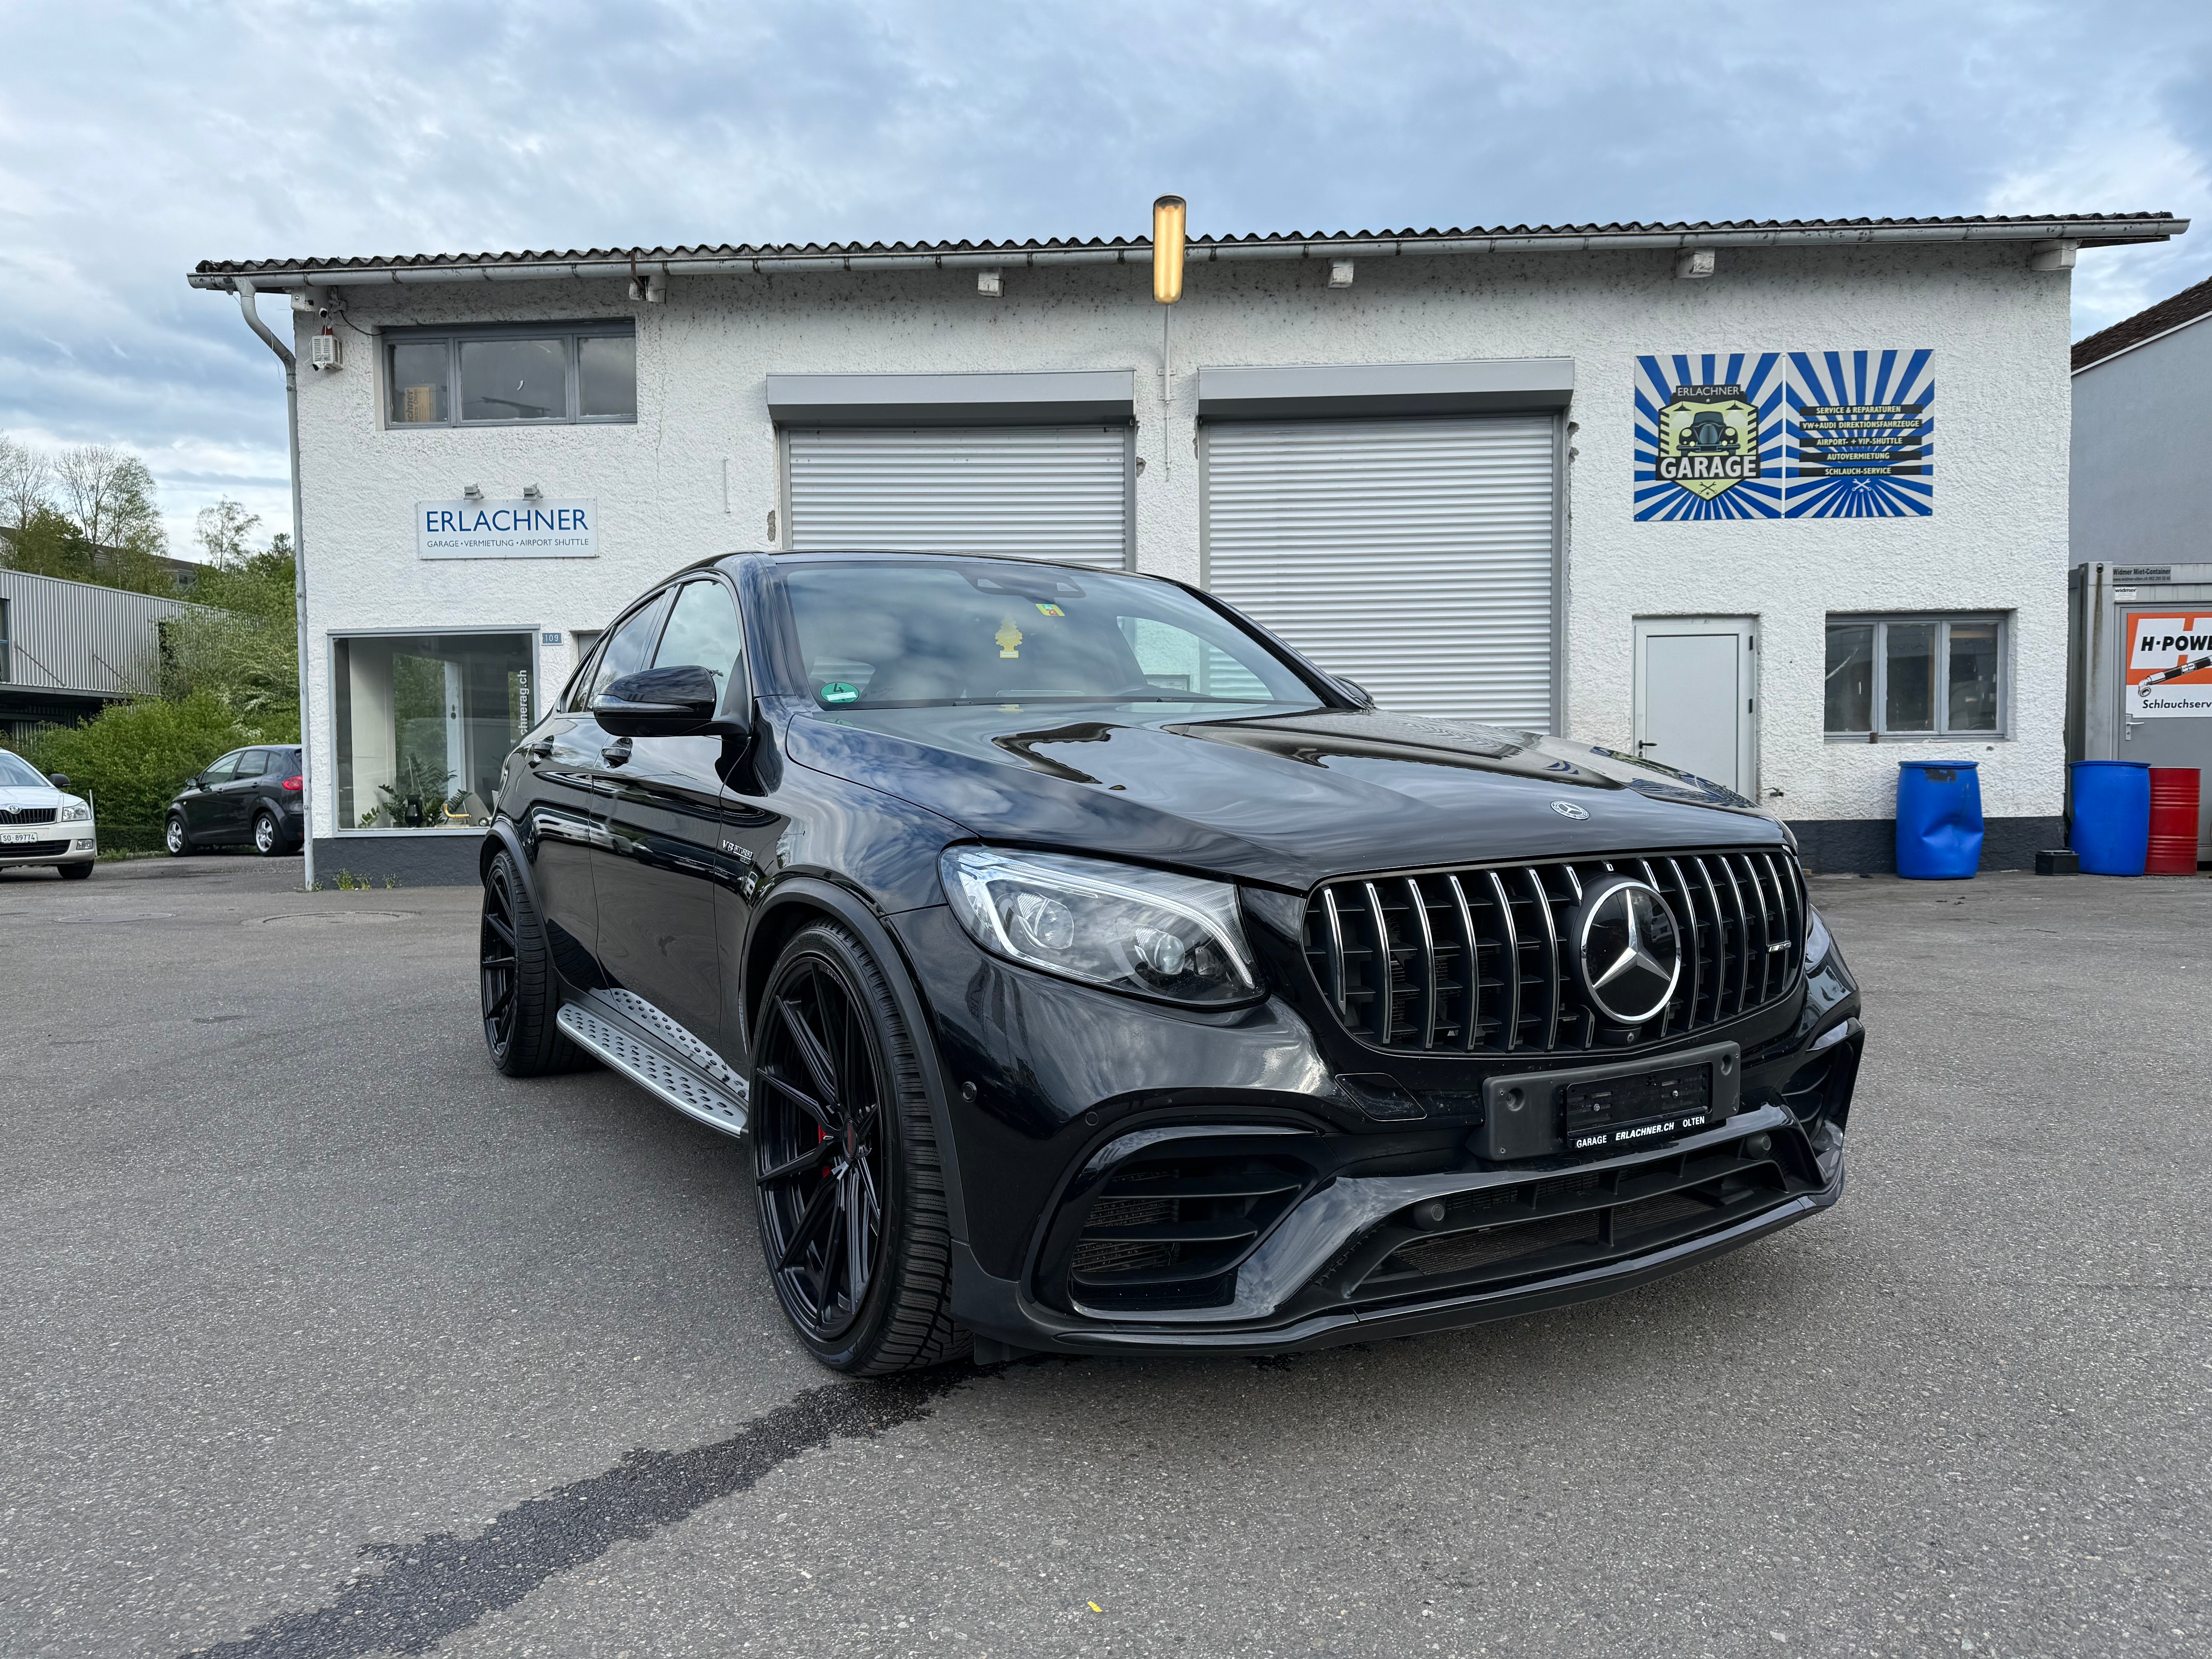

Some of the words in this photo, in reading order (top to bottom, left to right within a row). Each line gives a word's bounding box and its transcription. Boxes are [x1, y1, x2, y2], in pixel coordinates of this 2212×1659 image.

[1678, 386, 1740, 396] ERLACHNER
[1661, 456, 1757, 479] GARAGE
[426, 509, 589, 532] ERLACHNER
[833, 683, 844, 693] 4
[1576, 1135, 1607, 1148] GARAGE
[1615, 1121, 1674, 1141] ERLACHNER.CH
[1683, 1116, 1705, 1128] OLTEN
